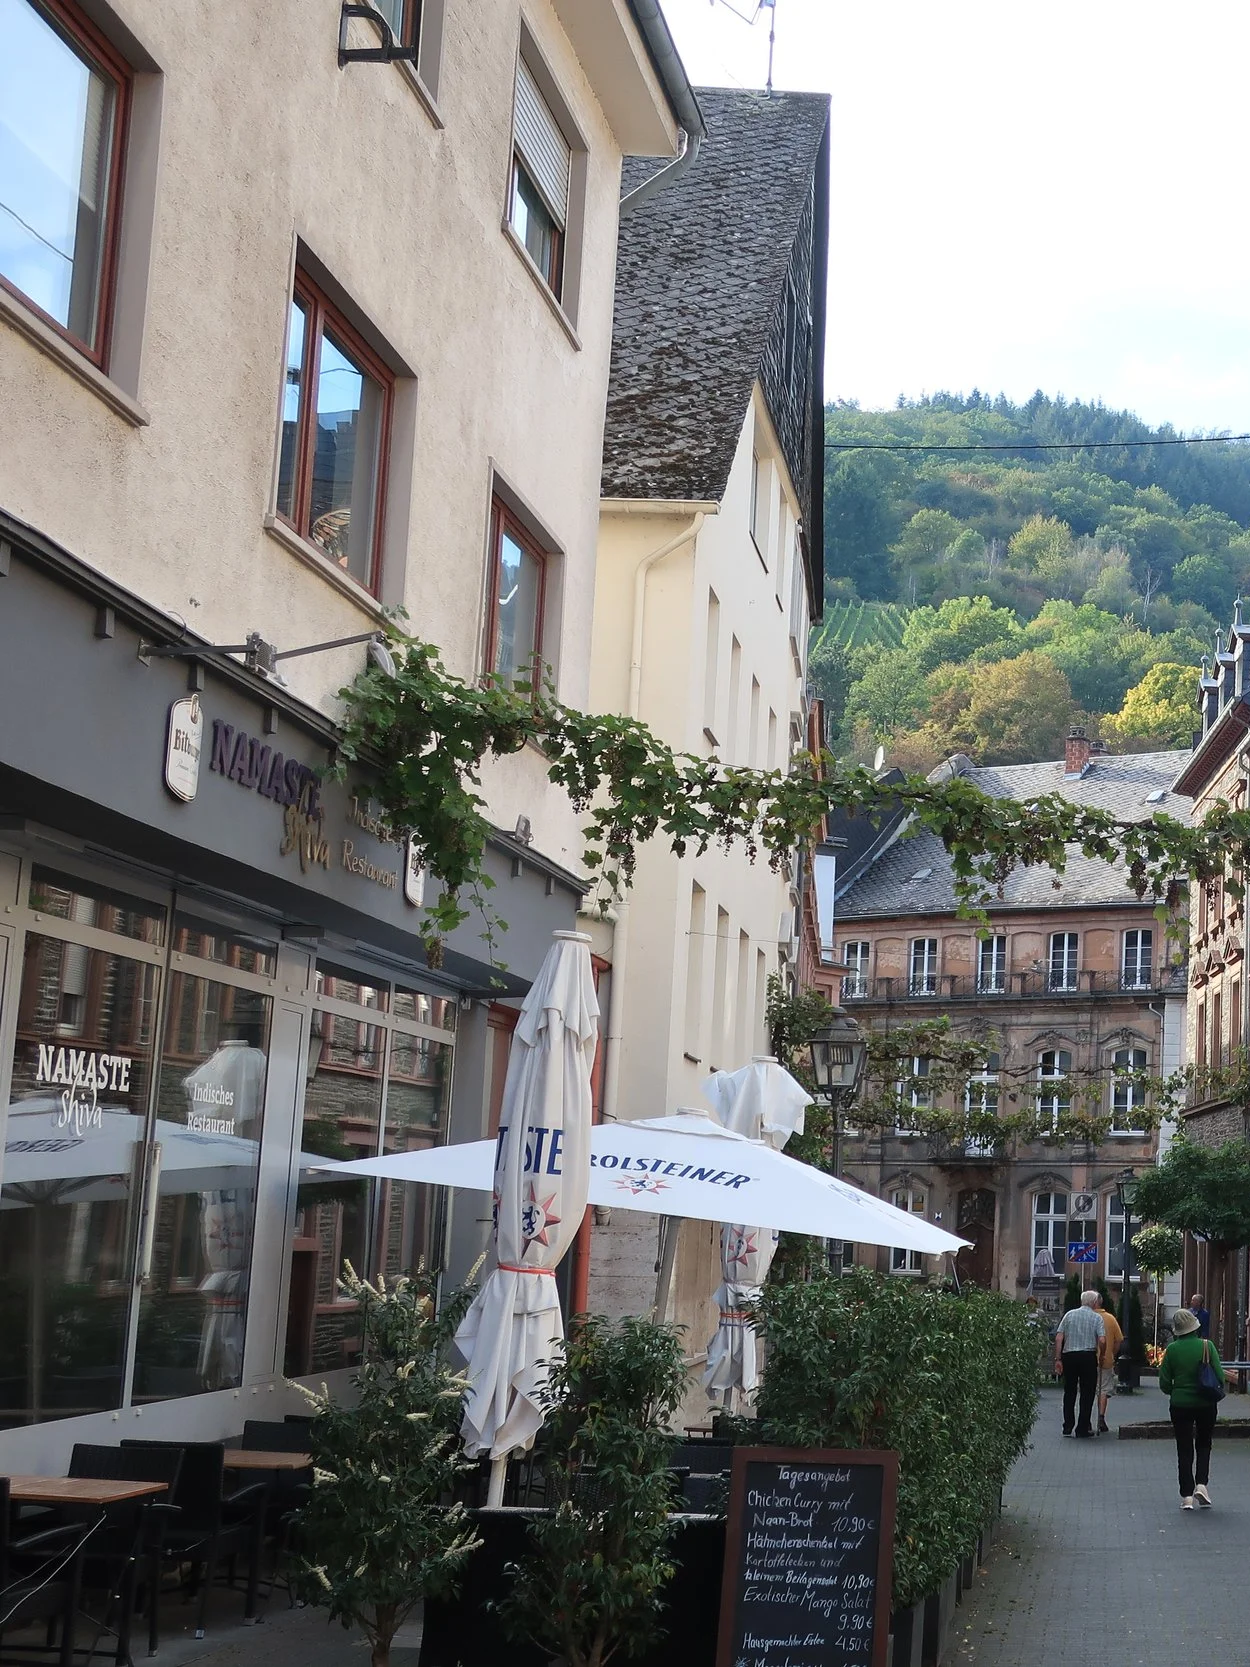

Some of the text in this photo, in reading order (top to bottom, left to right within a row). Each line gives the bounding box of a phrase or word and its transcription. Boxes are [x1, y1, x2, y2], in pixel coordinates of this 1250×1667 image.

[211, 718, 325, 822] NAMASTE
[343, 839, 398, 889] Restaurant
[36, 1043, 132, 1092] NAMASTE
[58, 1072, 102, 1137] Shiva
[193, 1082, 234, 1106] Indisches
[187, 1111, 236, 1136] Restaurant
[778, 1465, 851, 1490] Tagesangebot
[748, 1489, 854, 1513] Chicken Curry mit
[753, 1511, 813, 1528] Naan-Brot
[841, 1535, 865, 1549] mit
[820, 1554, 845, 1567] und
[744, 1569, 783, 1582] kleinem
[786, 1570, 838, 1588] Beilagensalat
[743, 1586, 872, 1617] Exotischer Mango Salat
[743, 1632, 801, 1652] Hausgemachter
[803, 1633, 825, 1646] Eistee
